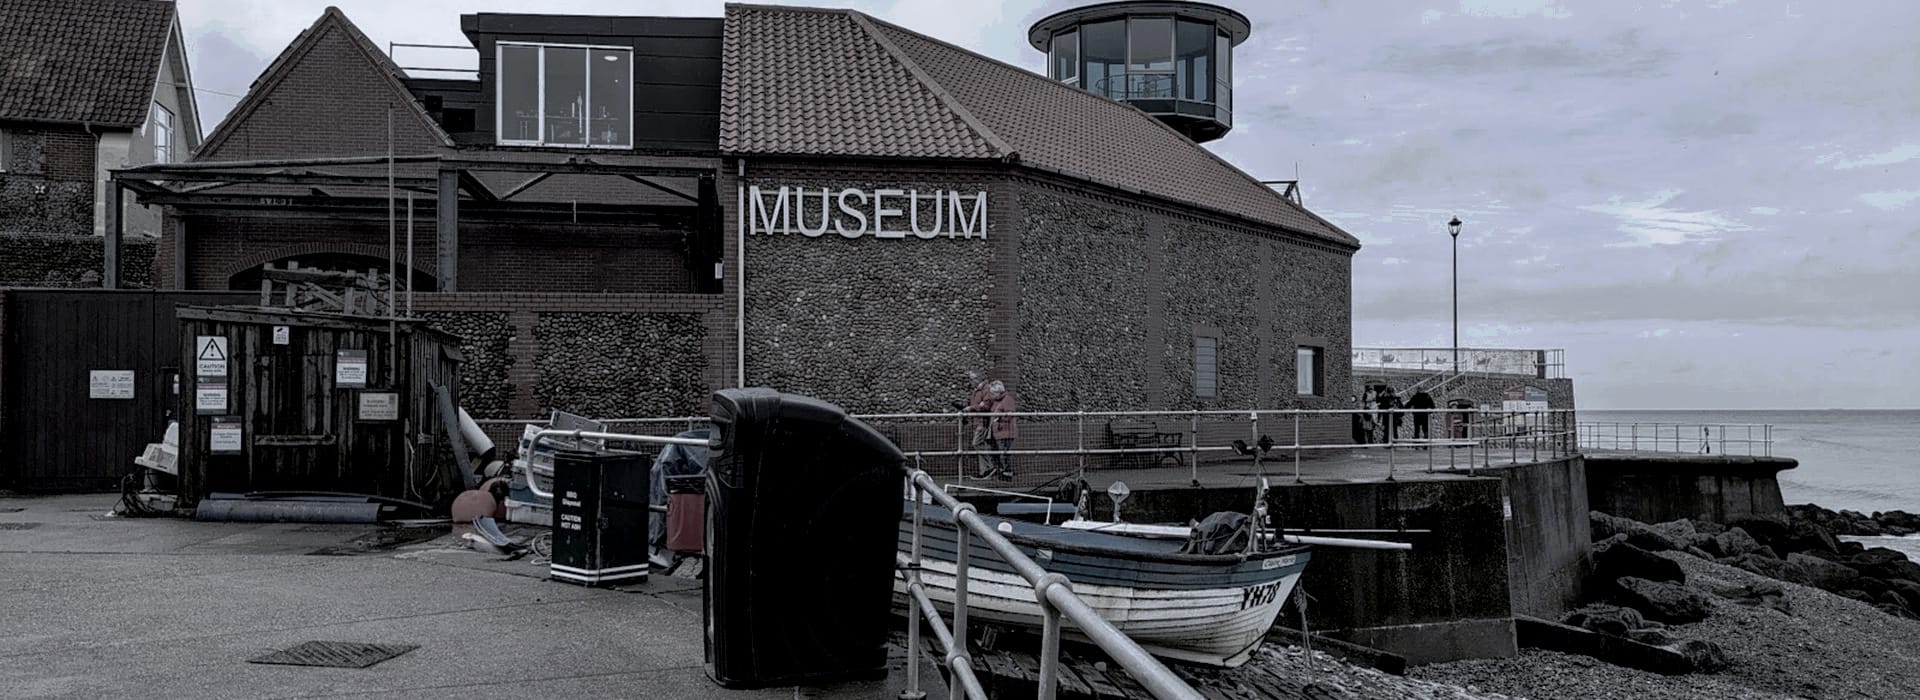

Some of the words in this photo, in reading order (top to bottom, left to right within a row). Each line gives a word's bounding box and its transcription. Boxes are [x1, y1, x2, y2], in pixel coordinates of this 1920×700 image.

[749, 185, 987, 240] MUSEUM
[561, 513, 581, 522] CAUTION
[1241, 580, 1281, 610] YH78
